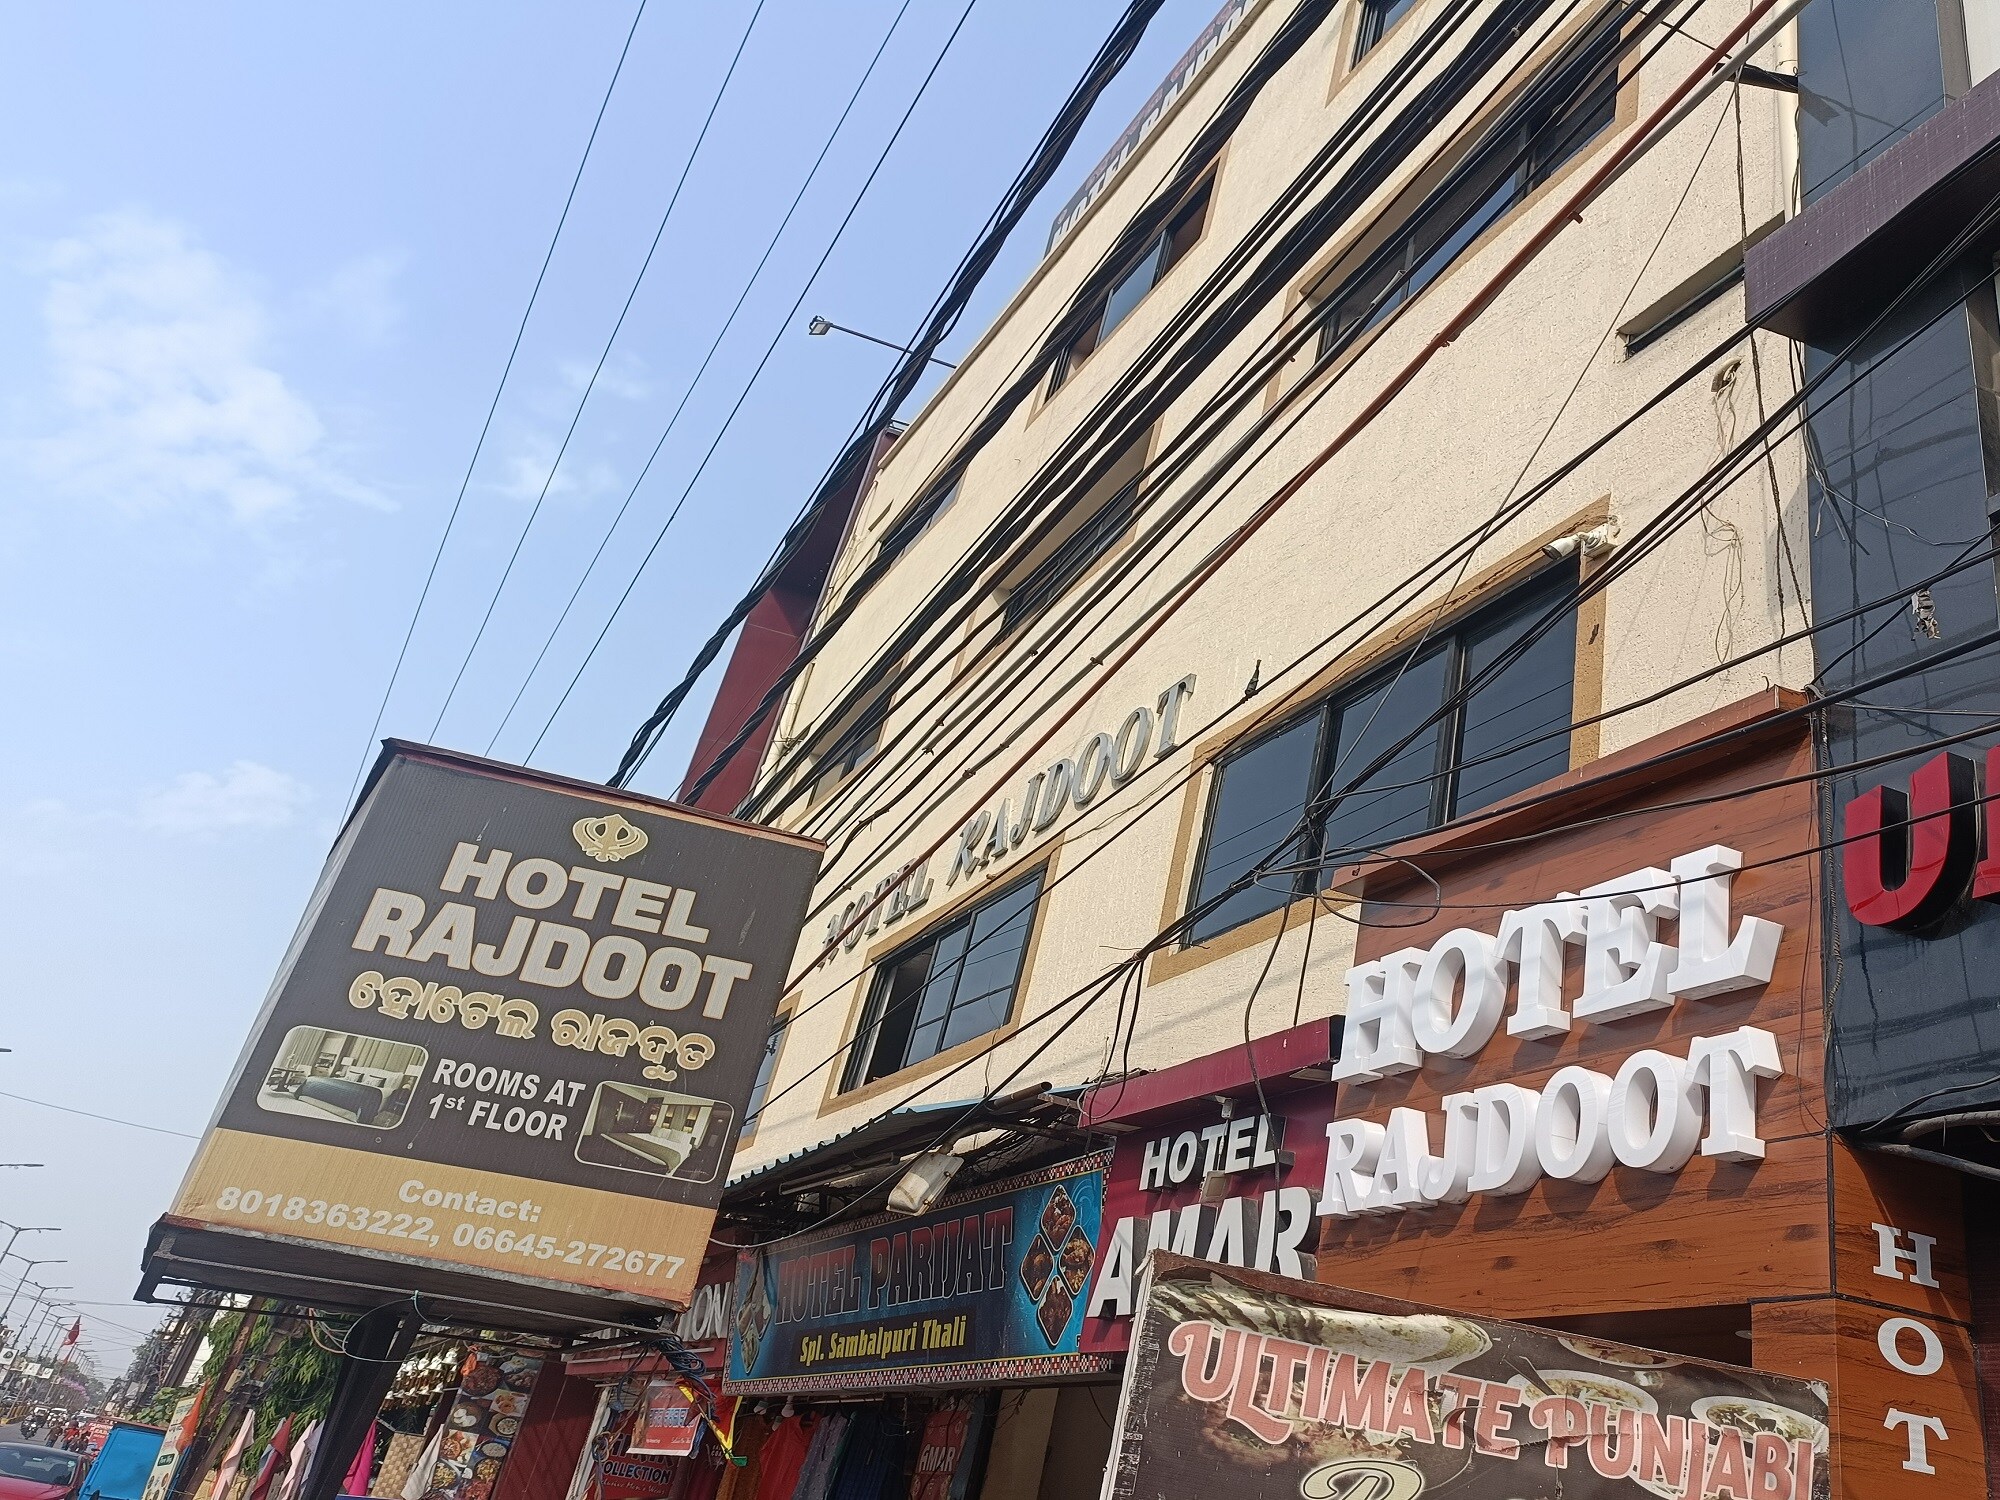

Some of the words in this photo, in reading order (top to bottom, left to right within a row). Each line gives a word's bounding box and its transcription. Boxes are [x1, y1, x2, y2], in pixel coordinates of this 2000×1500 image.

[818, 856, 934, 968] HOTEL
[946, 673, 1198, 886] RAJDOOT
[439, 841, 710, 944] HOTEL
[351, 887, 752, 1020] RAJDOOT
[1331, 844, 1785, 1085] HOTEL
[348, 970, 540, 1040] ହୋଟେଲ
[428, 1092, 467, 1120] 1st
[467, 1100, 568, 1142] FLOOR
[432, 1058, 541, 1100] ROOMS
[543, 1079, 587, 1108] AT
[1317, 1025, 1785, 1220] RAJDOOT
[398, 1179, 542, 1223] Contact:
[1138, 1113, 1288, 1192] HOTEL
[216, 1186, 440, 1248] 8018363222,
[452, 1223, 686, 1279] 06645-272677
[775, 1244, 862, 1325] HOTEL
[867, 1206, 1014, 1310] PARIJAT
[1086, 1186, 1316, 1318] AMAR
[800, 1339, 825, 1367] Spl.
[828, 1321, 918, 1362] Sambalpuri
[921, 1315, 968, 1350] Thali
[1167, 1320, 1524, 1460] ULTIMATE
[1529, 1395, 1815, 1500] PUNJABI
[602, 1460, 673, 1485] OLLECTION
